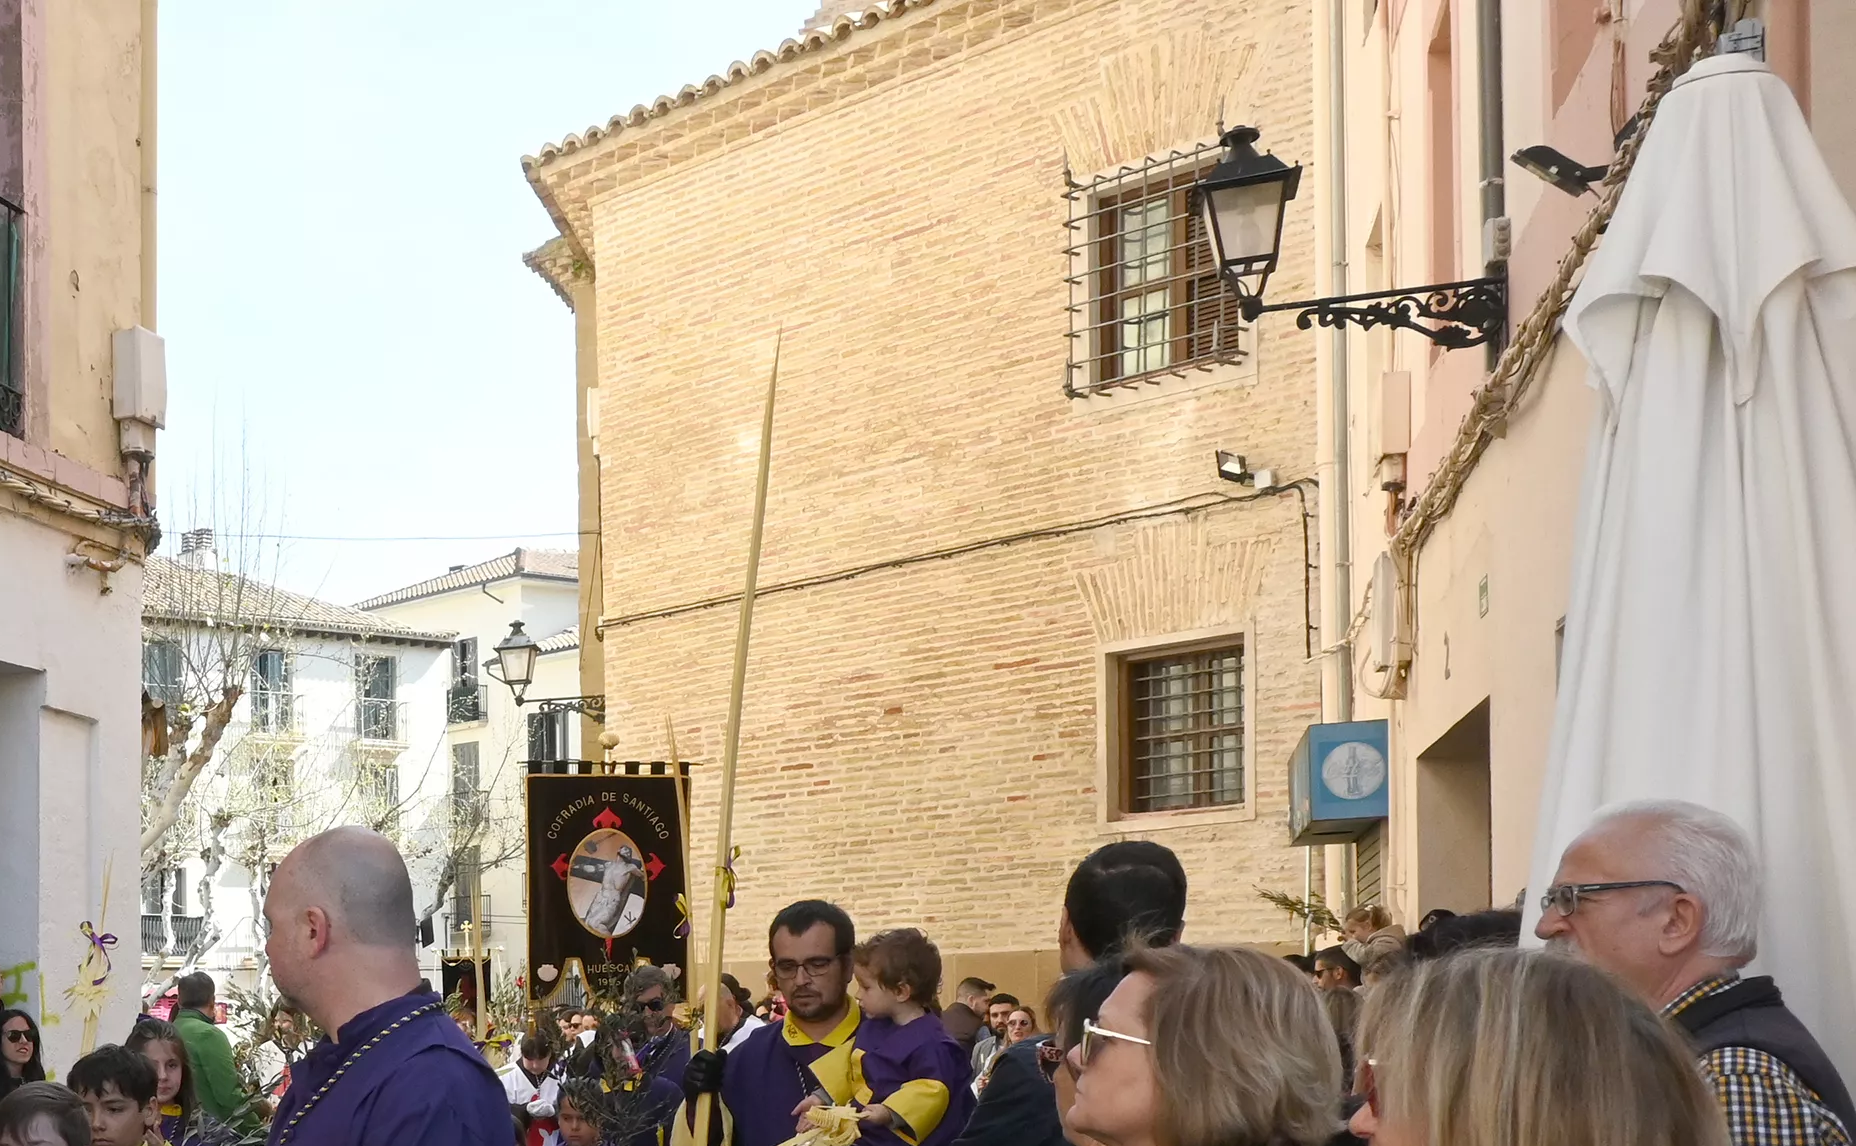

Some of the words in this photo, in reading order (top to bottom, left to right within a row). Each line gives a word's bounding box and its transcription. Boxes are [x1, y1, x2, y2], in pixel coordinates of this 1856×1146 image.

[547, 794, 595, 840] COFRADIA
[601, 791, 617, 802] DE
[622, 793, 670, 840] SANTIAGO
[587, 963, 631, 974] HUESCA
